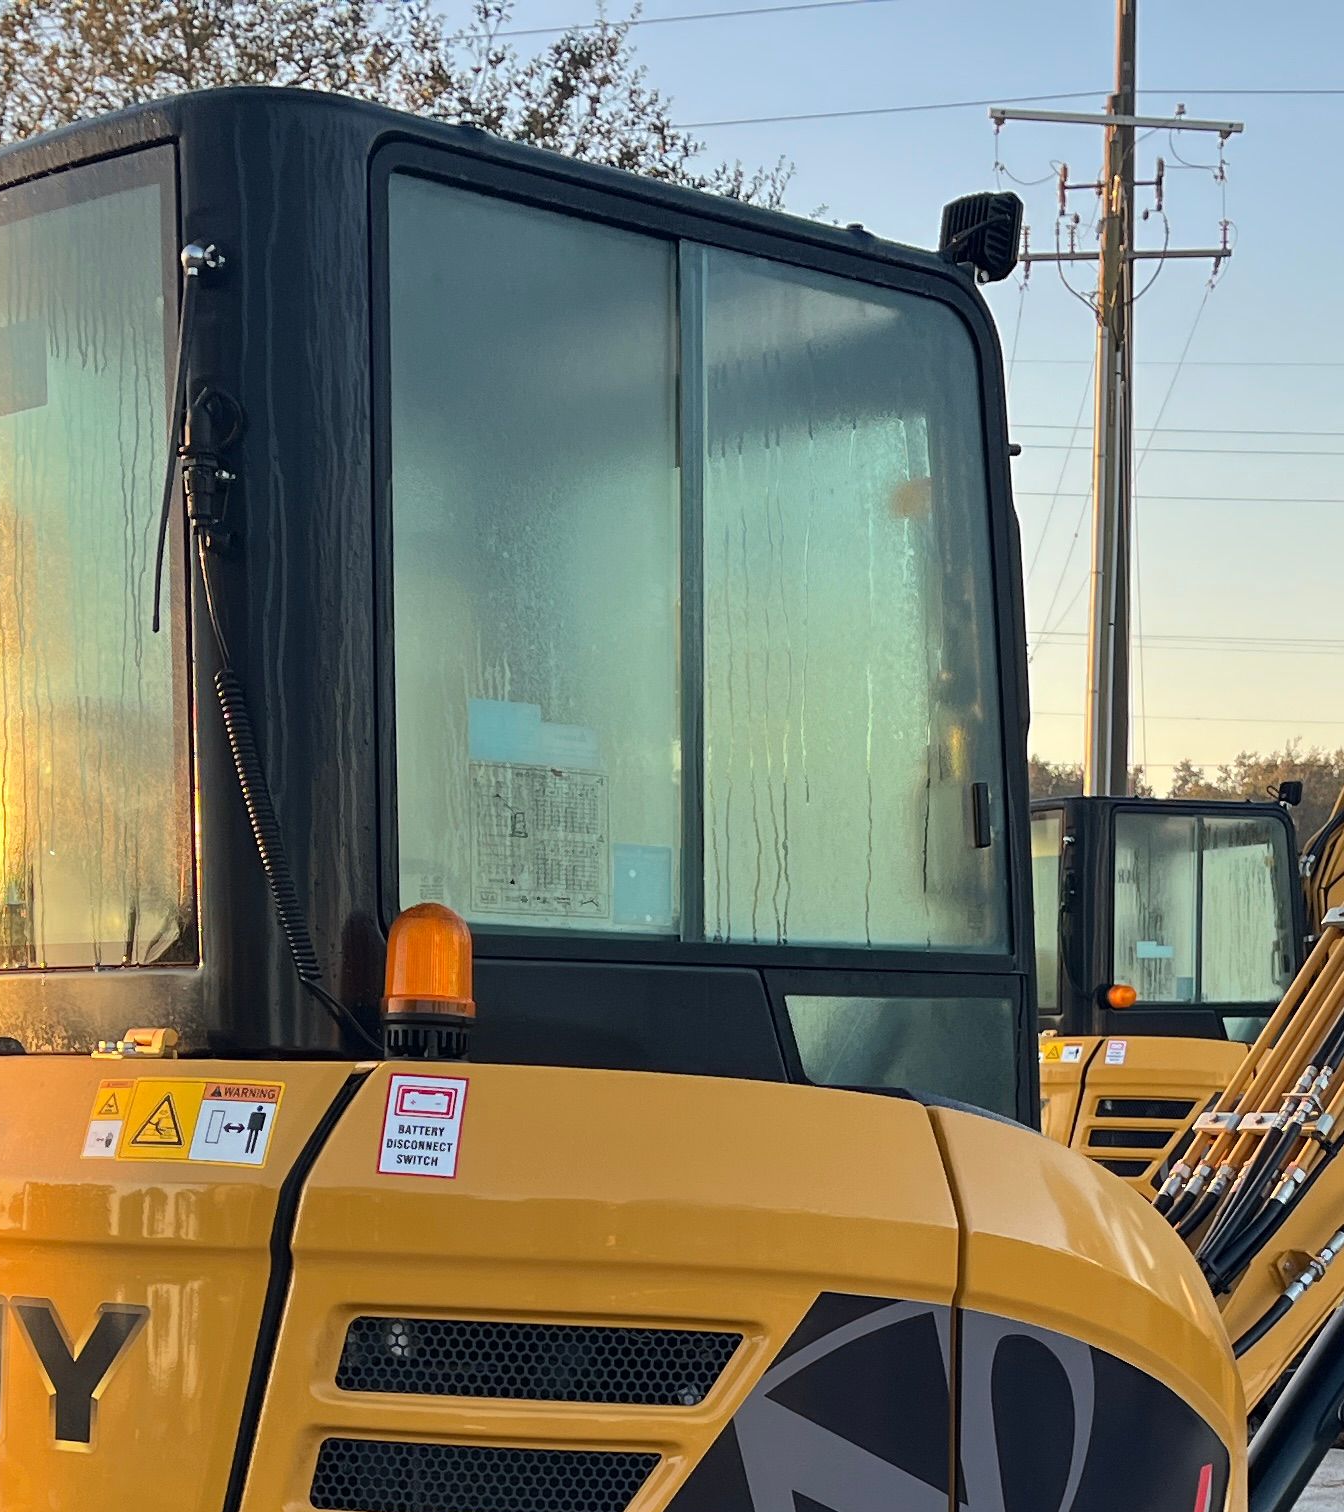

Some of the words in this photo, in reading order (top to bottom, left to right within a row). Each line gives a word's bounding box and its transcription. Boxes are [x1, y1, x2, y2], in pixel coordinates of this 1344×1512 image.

[223, 1086, 277, 1100] WARNING
[398, 1124, 445, 1137] BATTERY
[386, 1138, 453, 1152] DISCONNECT
[396, 1154, 438, 1167] SWITCH
